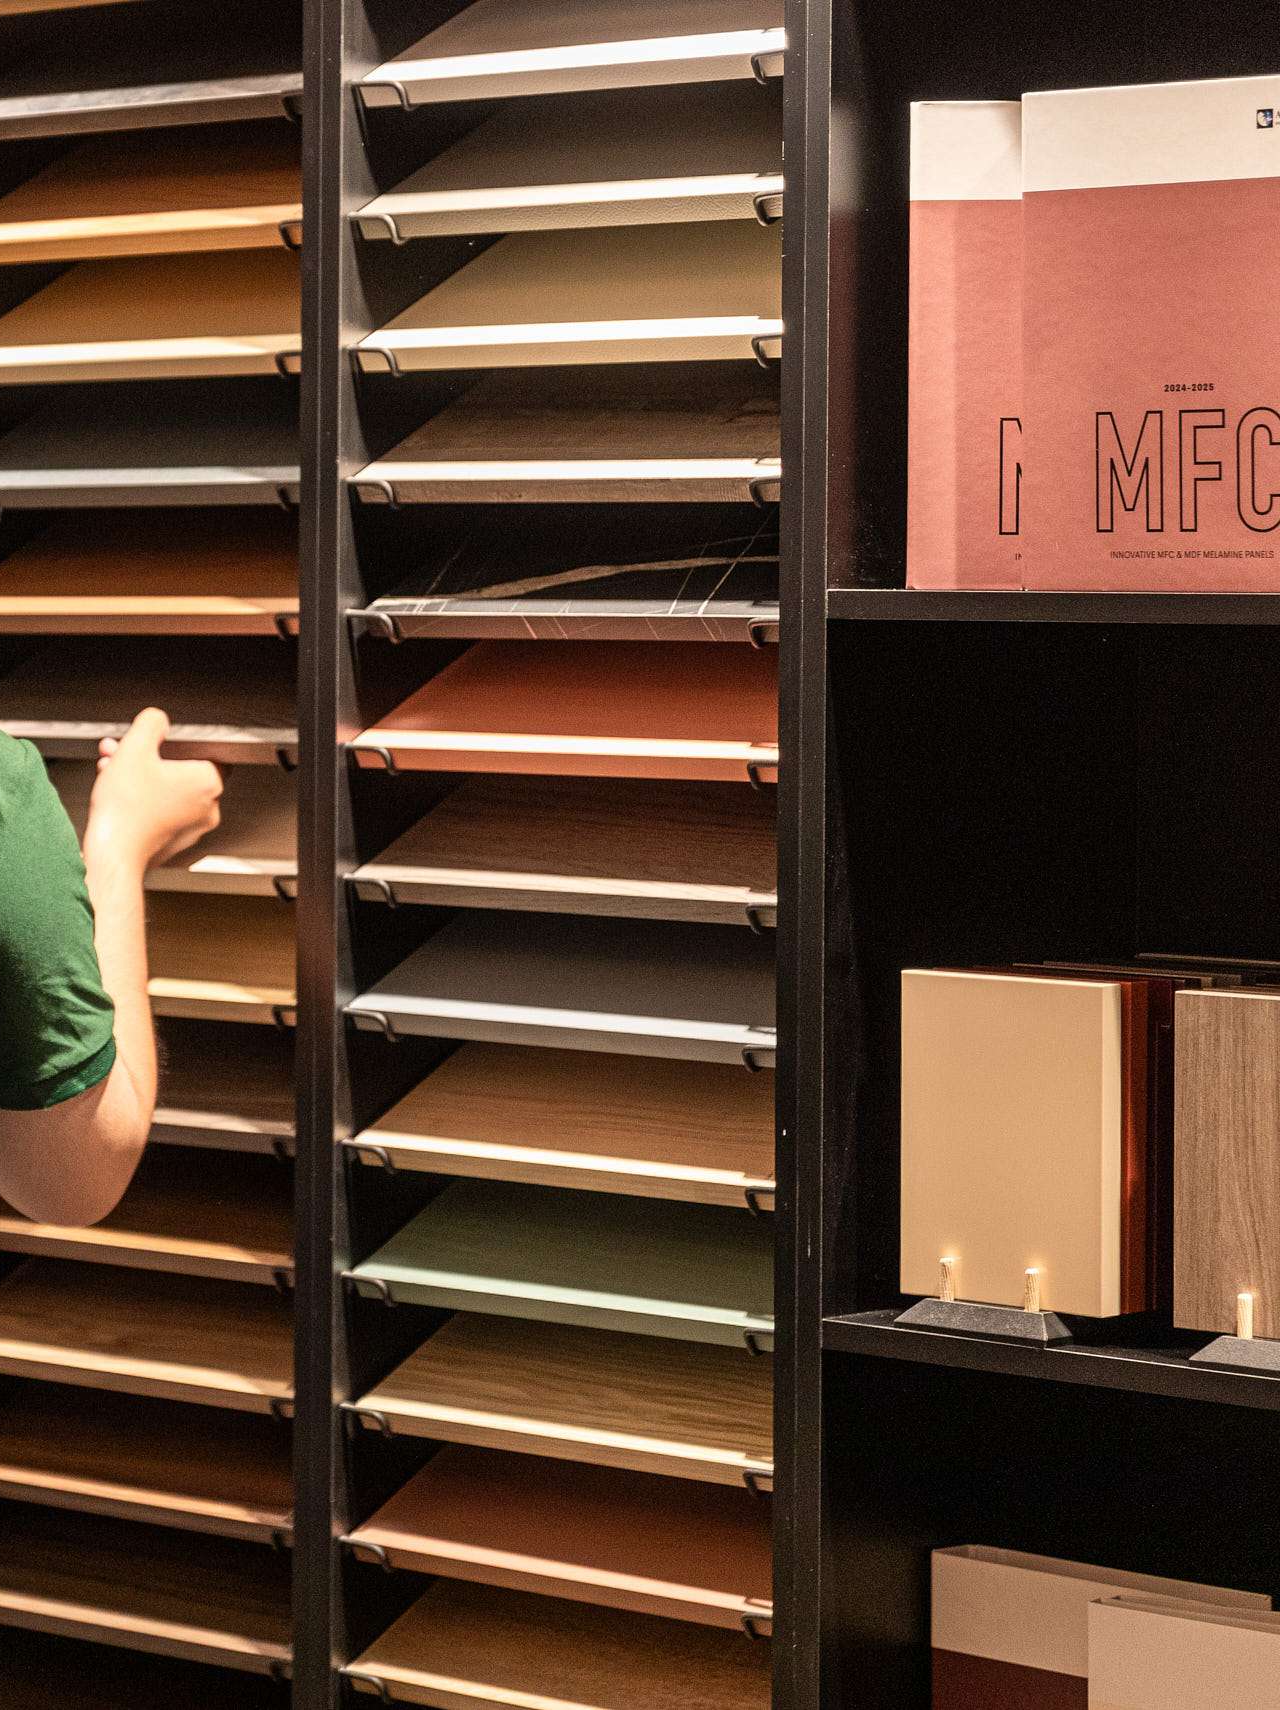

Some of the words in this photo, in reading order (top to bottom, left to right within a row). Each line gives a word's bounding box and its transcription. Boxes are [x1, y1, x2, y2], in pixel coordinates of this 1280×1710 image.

[1164, 383, 1215, 393] 2024-2025
[1095, 406, 1280, 533] MFC
[1110, 550, 1156, 559] INNOVATIVE
[1157, 550, 1175, 559] MFC
[1176, 550, 1183, 559] &
[1184, 550, 1201, 559] MDF
[1203, 550, 1243, 559] MELAMINE
[1245, 550, 1275, 559] PANELS
